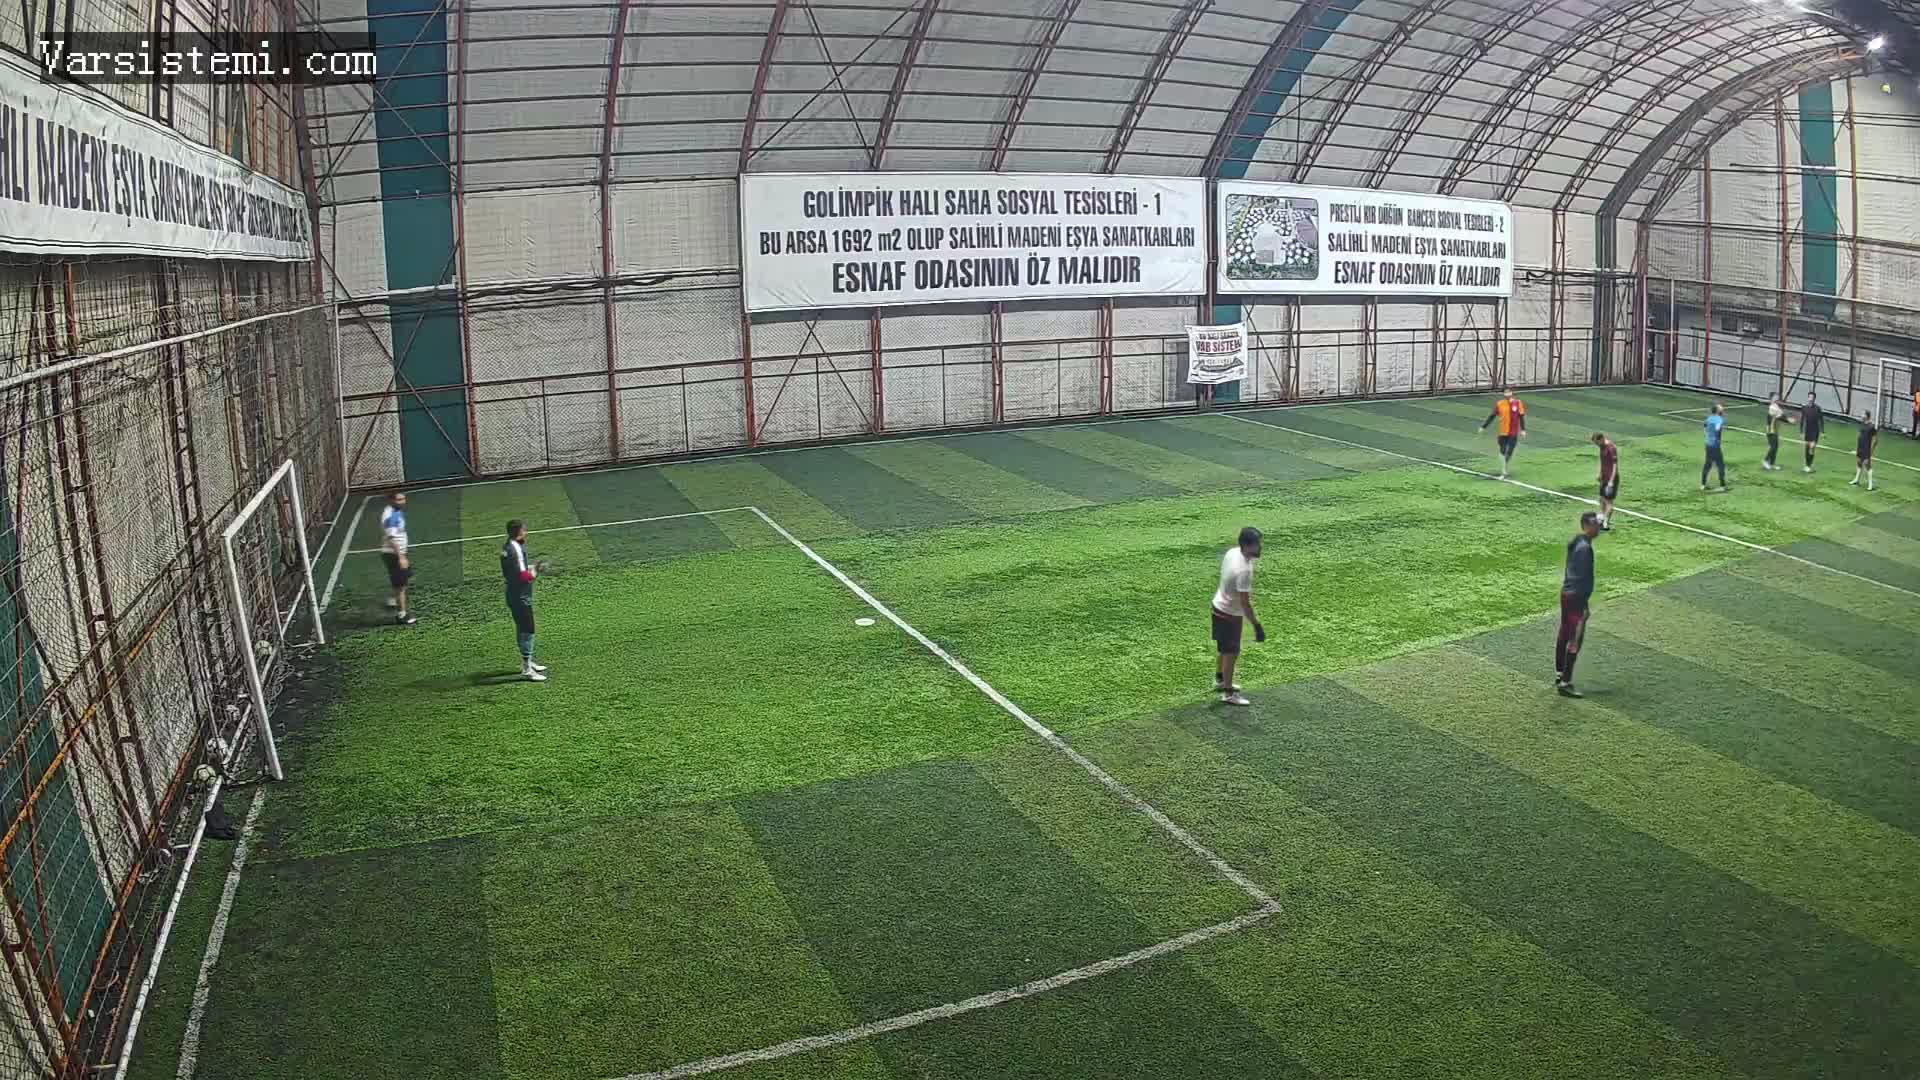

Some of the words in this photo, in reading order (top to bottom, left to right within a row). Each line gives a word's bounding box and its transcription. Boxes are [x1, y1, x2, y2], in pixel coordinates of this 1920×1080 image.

[112, 143, 149, 227] EŞYA
[804, 186, 893, 218] GOLİMPİK
[900, 190, 939, 216] HALI
[945, 190, 991, 216] SAHA
[997, 189, 1058, 216] SOSYAL
[1064, 187, 1138, 215] TESİSLERİ
[1154, 193, 1161, 216] 1
[760, 231, 781, 255] BU
[786, 230, 828, 254] ARSA
[832, 229, 873, 252] 1692
[878, 228, 901, 251] m2
[907, 227, 944, 250] OLUP
[949, 222, 1003, 249] SALİHLİ
[1007, 222, 1061, 248] MADENİ
[1067, 226, 1099, 250] EŞYA
[1103, 226, 1195, 247] SANATKARLARI
[1328, 230, 1368, 252] SALİHLİ
[1372, 233, 1411, 254] MADENİ
[1415, 236, 1438, 258] EŞYA
[1440, 238, 1506, 259] SANATKARLARI
[832, 261, 906, 293] ESNAF
[914, 257, 1019, 290] ODASININ
[1027, 252, 1050, 286] ÖZ
[1058, 256, 1141, 285] MALIDIR
[1334, 260, 1376, 284] ESNAF
[1379, 262, 1436, 285] ODASININ
[1439, 260, 1453, 285] ÖZ
[1456, 265, 1501, 287] MALIDIR
